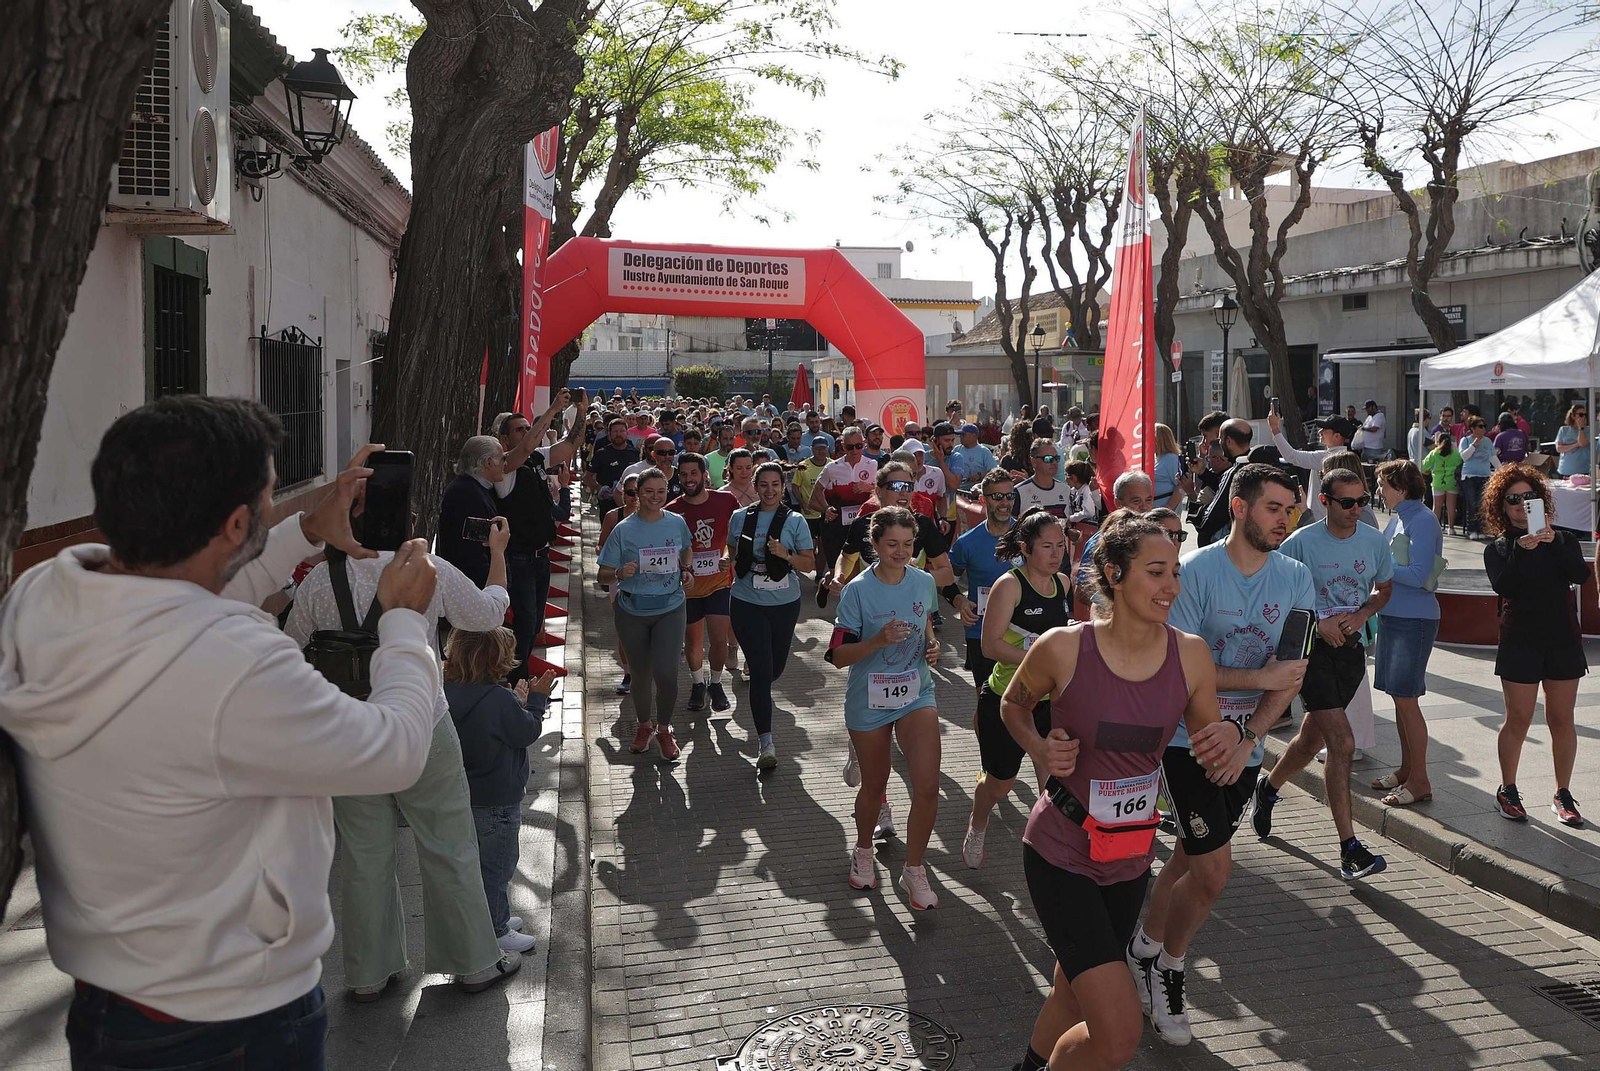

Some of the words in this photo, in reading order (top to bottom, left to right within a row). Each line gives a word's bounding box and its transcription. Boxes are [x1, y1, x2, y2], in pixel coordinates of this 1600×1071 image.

[623, 252, 703, 271] Delegación
[706, 257, 723, 272] de
[726, 258, 789, 276] Deportes
[623, 269, 656, 283] Ilustre
[657, 271, 725, 287] Ayuntamiento
[726, 275, 738, 287] de
[740, 276, 758, 288] San
[760, 278, 789, 290] Roque
[650, 557, 668, 566] 241
[696, 559, 714, 568] 296
[1326, 575, 1359, 588] CARRERA
[1212, 638, 1227, 651] VIII
[1225, 624, 1271, 645] CARRERA
[882, 685, 908, 698] 149
[1099, 781, 1117, 790] VIII
[1126, 783, 1153, 794] MAYORGA
[1113, 794, 1147, 818] 166
